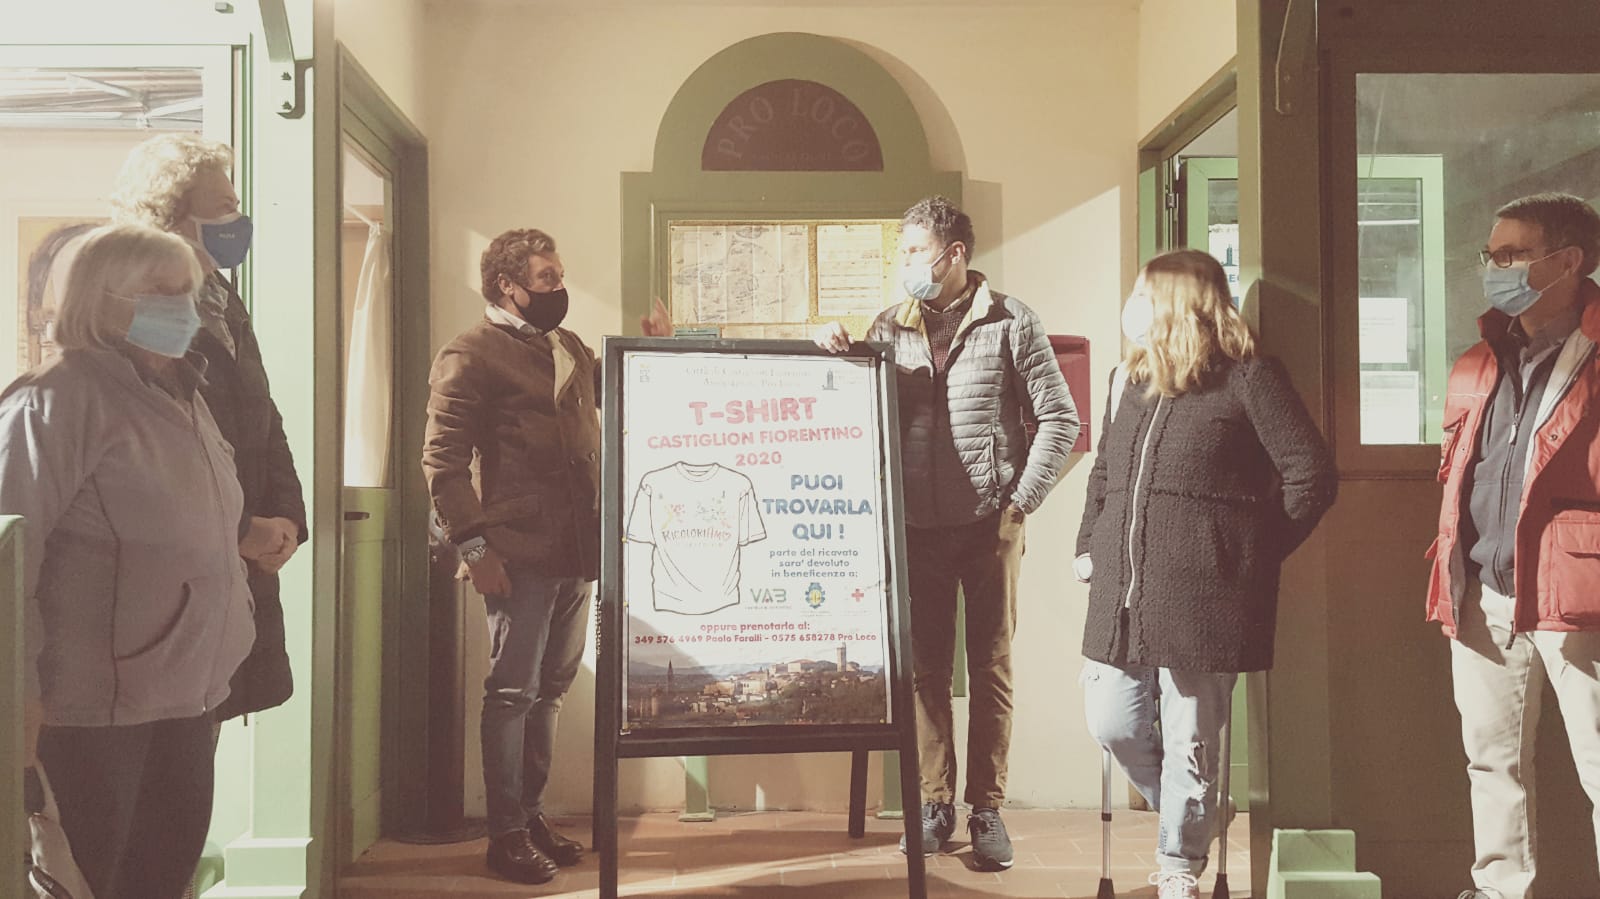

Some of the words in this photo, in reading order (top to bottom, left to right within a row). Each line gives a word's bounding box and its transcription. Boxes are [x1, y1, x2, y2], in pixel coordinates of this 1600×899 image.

[717, 96, 774, 160] PRO
[790, 87, 869, 160] LOCO
[689, 397, 817, 425] T-SHIRT
[647, 431, 754, 449] CASTIGLION
[760, 426, 863, 444] FIORENTINO
[735, 451, 782, 466] 2020
[790, 474, 843, 490] PUOI
[762, 498, 873, 515] TROVARLA
[792, 523, 832, 541] QUI
[769, 548, 797, 559] parte
[800, 548, 815, 557] del
[818, 548, 859, 557] ricavato
[807, 559, 850, 567] devoluto
[771, 569, 781, 577] in
[783, 569, 846, 577] beneficenza
[700, 623, 737, 633] oppure
[740, 621, 795, 633] prenotarla
[798, 621, 810, 630] al:
[634, 635, 654, 645] 349
[656, 635, 675, 644] 576
[706, 634, 732, 643] Paolo
[734, 633, 762, 642] Faralli
[771, 634, 797, 642] 0575
[800, 633, 835, 642] 658278
[838, 633, 853, 641] Pro
[855, 633, 877, 641] Loco
